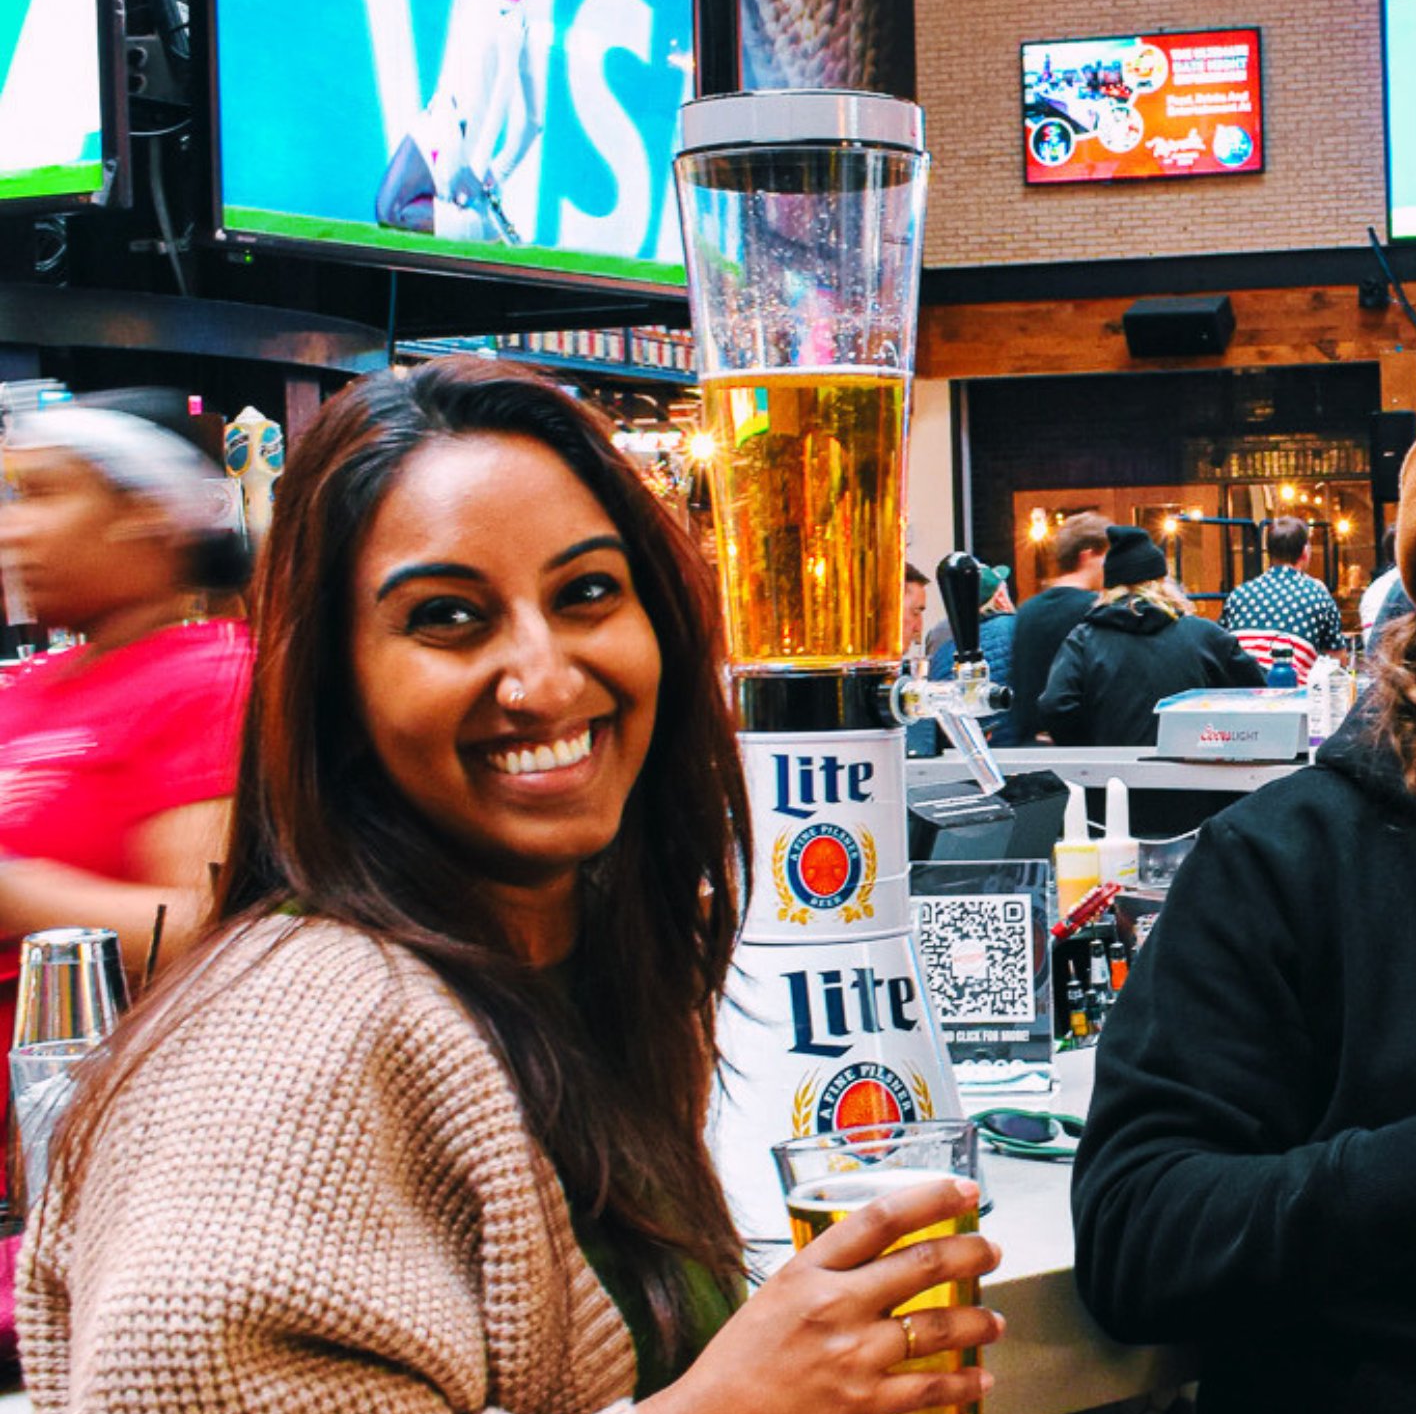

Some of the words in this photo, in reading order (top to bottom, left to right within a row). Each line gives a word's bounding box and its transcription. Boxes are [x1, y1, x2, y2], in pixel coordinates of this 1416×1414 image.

[771, 754, 874, 819] Lite
[794, 827, 818, 851] FINE
[821, 825, 860, 859] PILSNER
[810, 895, 842, 908] BEER
[779, 967, 918, 1058] Lite
[983, 1030, 999, 1042] FOR
[823, 1069, 856, 1105] FINE
[859, 1064, 912, 1111] PILSNER
[819, 1108, 831, 1120] A
